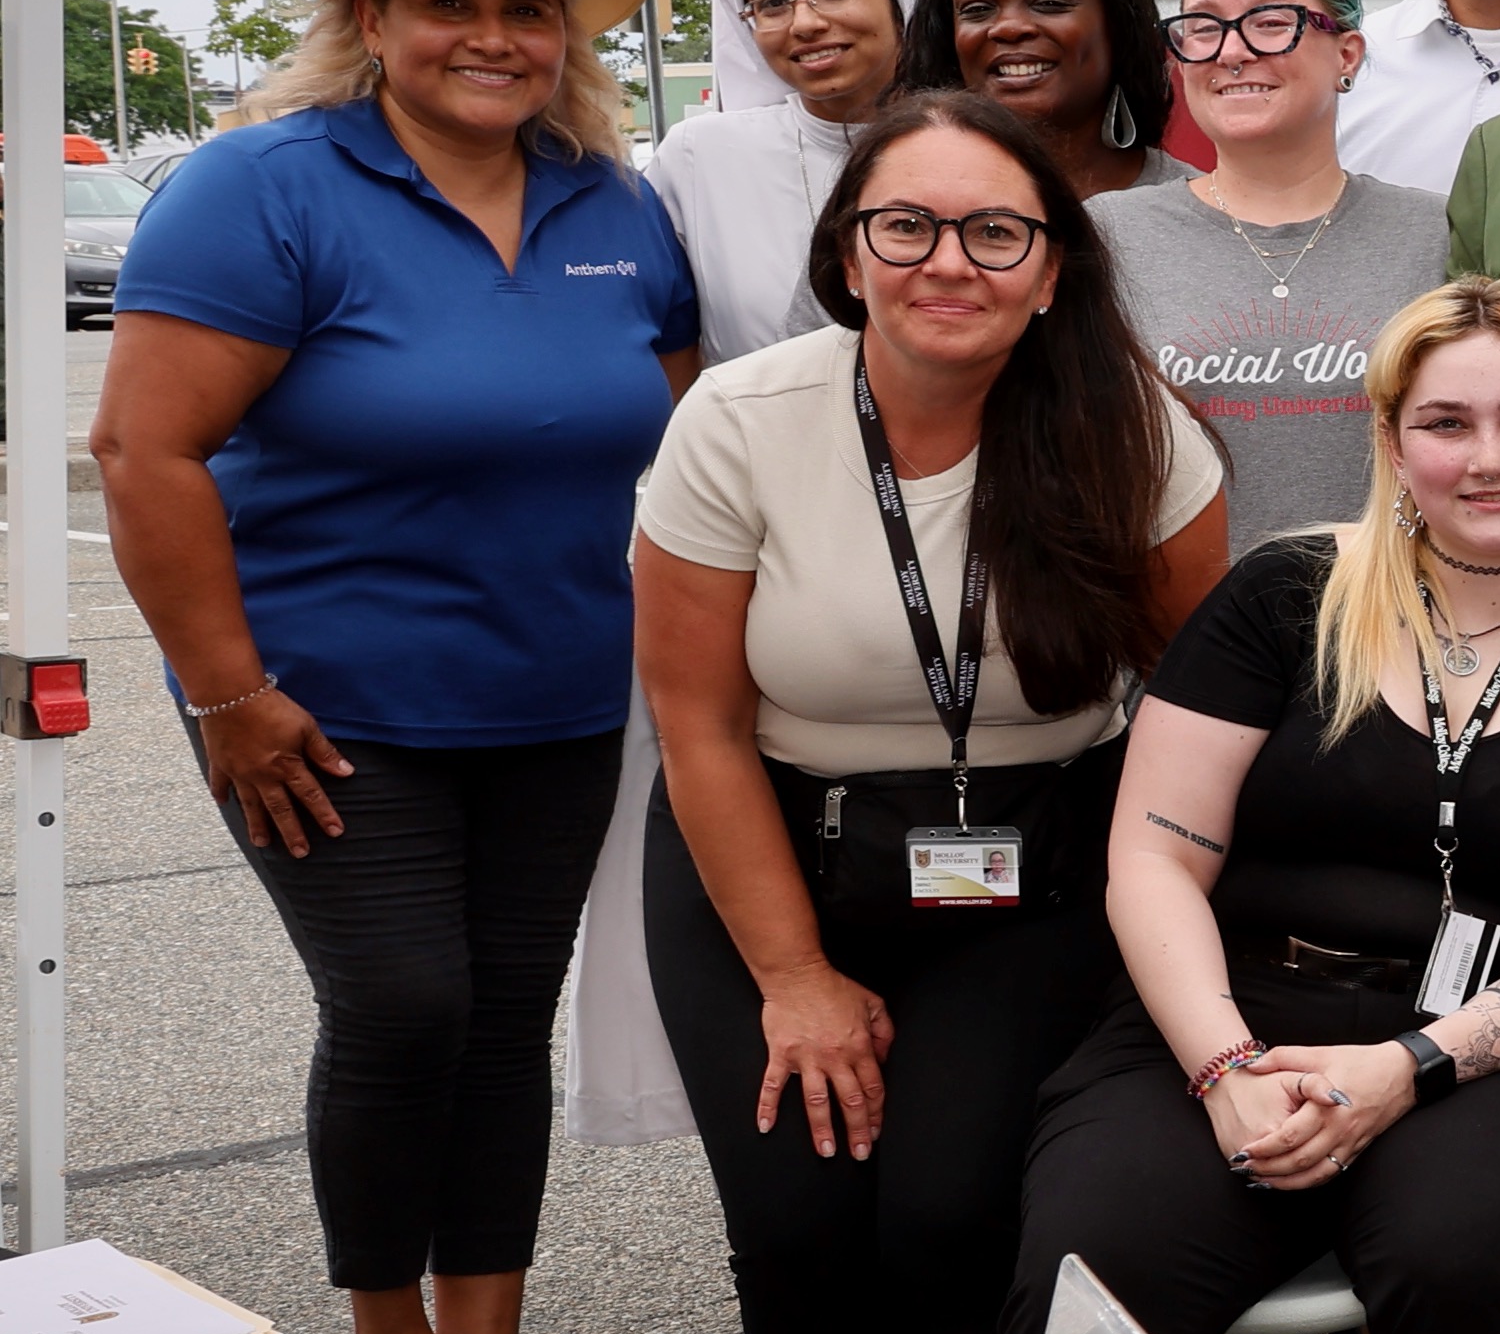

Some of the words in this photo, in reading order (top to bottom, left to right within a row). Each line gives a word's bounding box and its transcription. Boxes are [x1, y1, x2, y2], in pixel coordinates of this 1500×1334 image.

[565, 263, 616, 276] Anthem
[874, 472, 891, 510] MOLLOY
[881, 462, 901, 518] UNIVERSITY
[900, 569, 916, 608] MOLLOY
[906, 559, 928, 615] UNIVERSITY
[926, 667, 943, 704] MOLLOY
[957, 652, 969, 708] UNIVERSITY
[965, 661, 976, 698] MOLLOY
[1433, 717, 1448, 744] Molloy
[1448, 744, 1471, 773] Molloy
[1460, 719, 1483, 747] College
